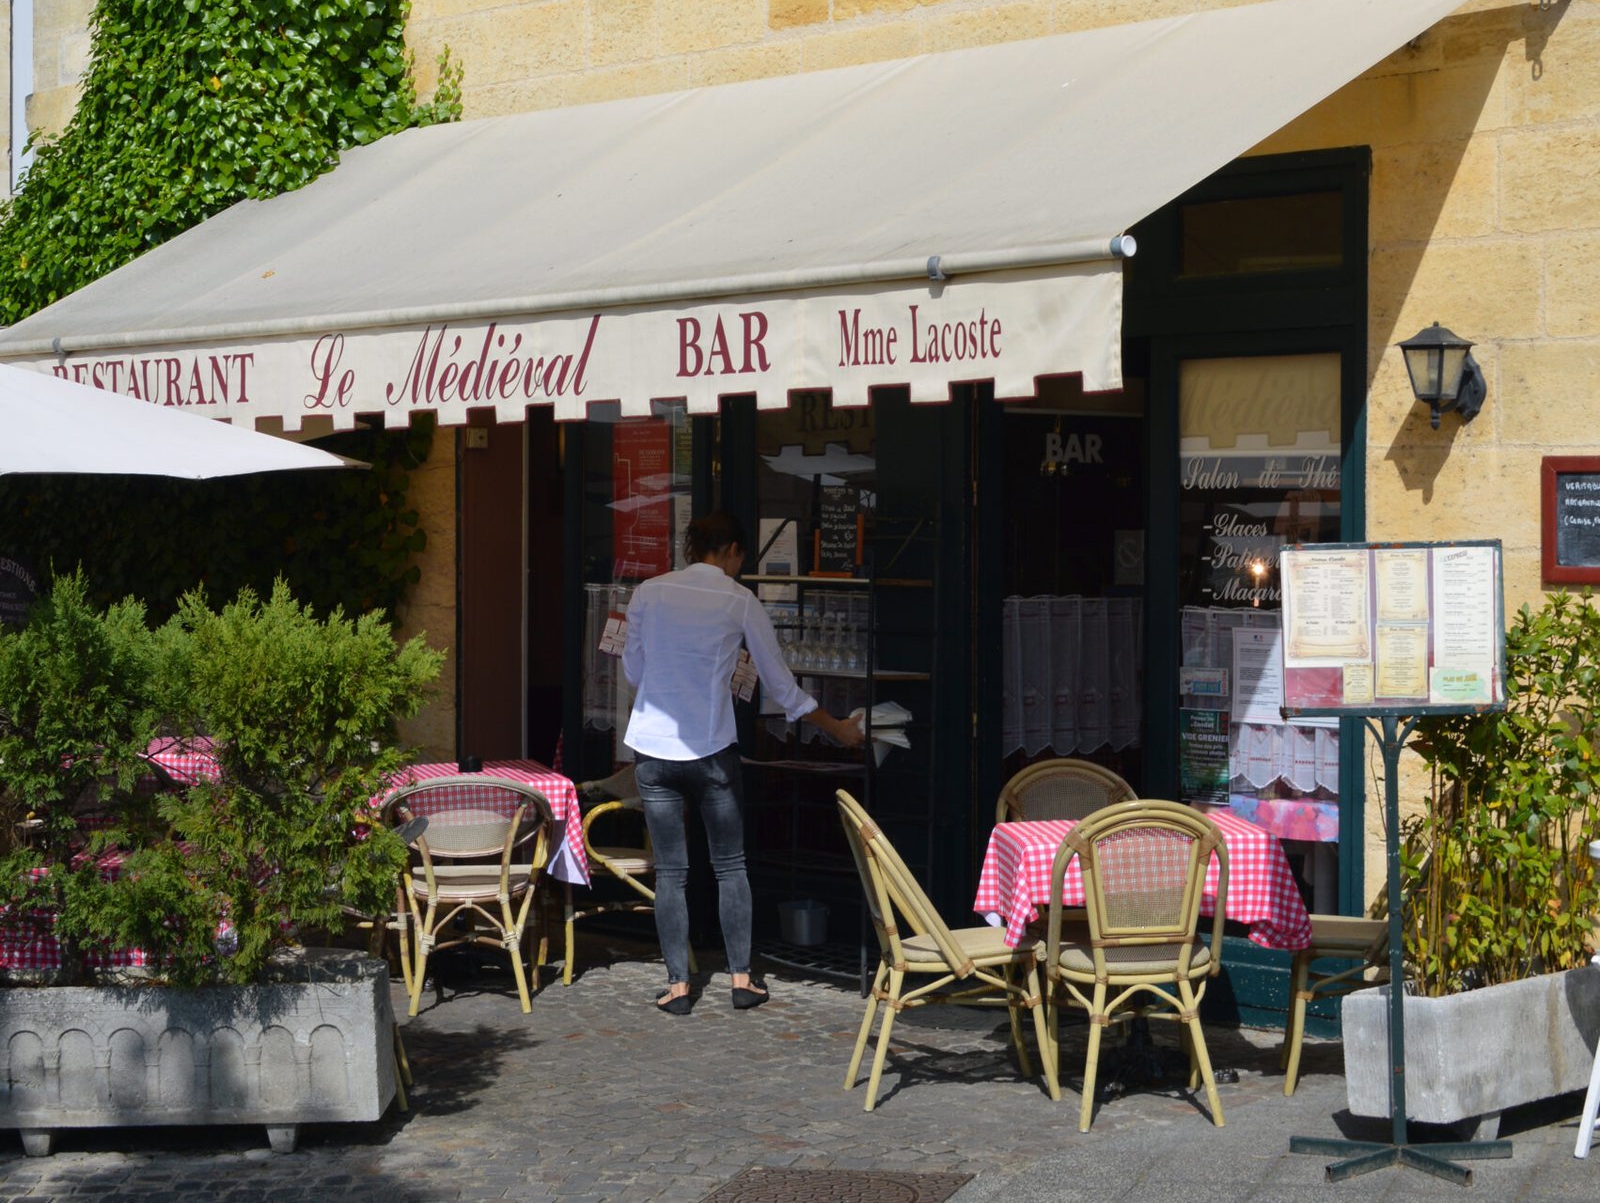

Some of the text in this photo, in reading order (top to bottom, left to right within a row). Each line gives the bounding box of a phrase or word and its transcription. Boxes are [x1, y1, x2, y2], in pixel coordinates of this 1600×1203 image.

[303, 332, 356, 409] Le
[385, 313, 602, 406] Médiéval
[676, 310, 772, 378] BAR
[838, 308, 898, 368] Mme
[909, 303, 1003, 365] Lacoste
[1045, 432, 1105, 464] BAR
[1183, 454, 1338, 491] Salon de Thé
